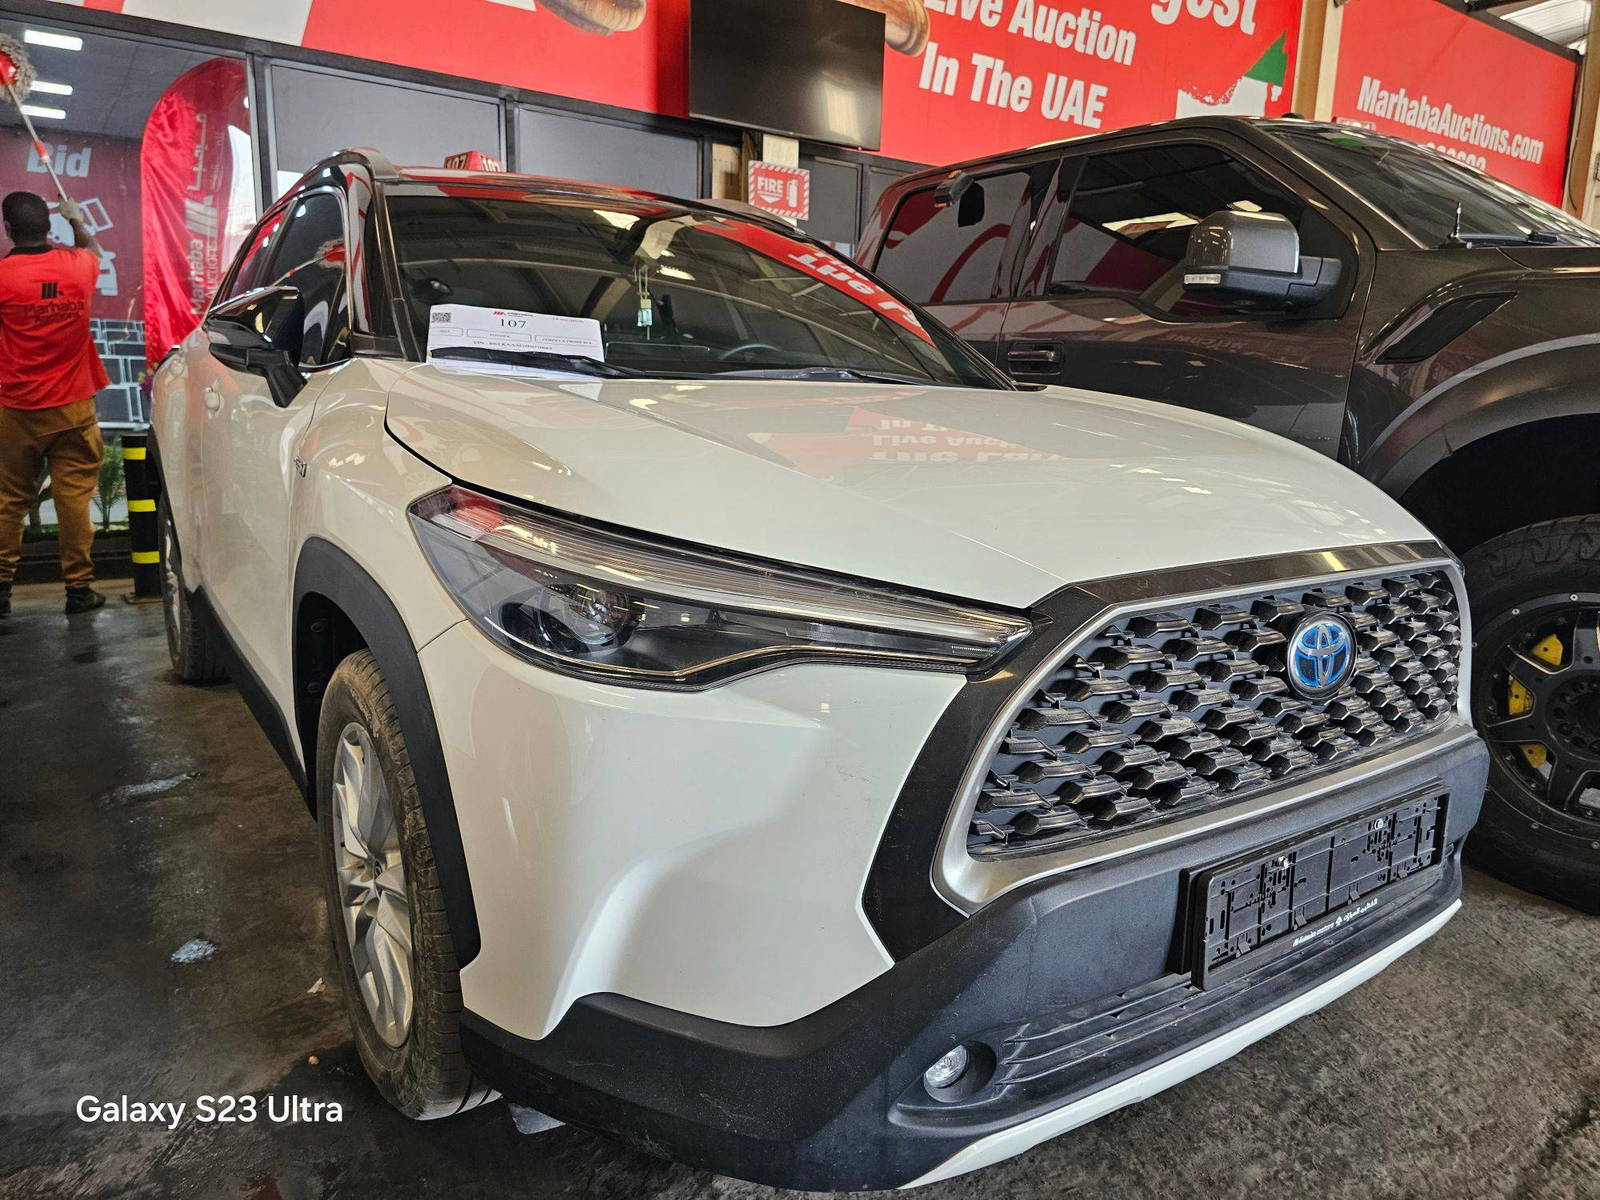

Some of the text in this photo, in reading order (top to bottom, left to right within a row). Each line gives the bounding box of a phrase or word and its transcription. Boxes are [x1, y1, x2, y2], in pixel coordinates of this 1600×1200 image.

[924, 0, 1136, 66] ve Auction
[919, 41, 1108, 129] In The UAE
[1356, 75, 1545, 165] MarhabaAuctions.com
[27, 142, 92, 178] Bid
[757, 176, 784, 193] FIRE
[190, 239, 206, 315] Marhaba
[501, 318, 527, 329] 107
